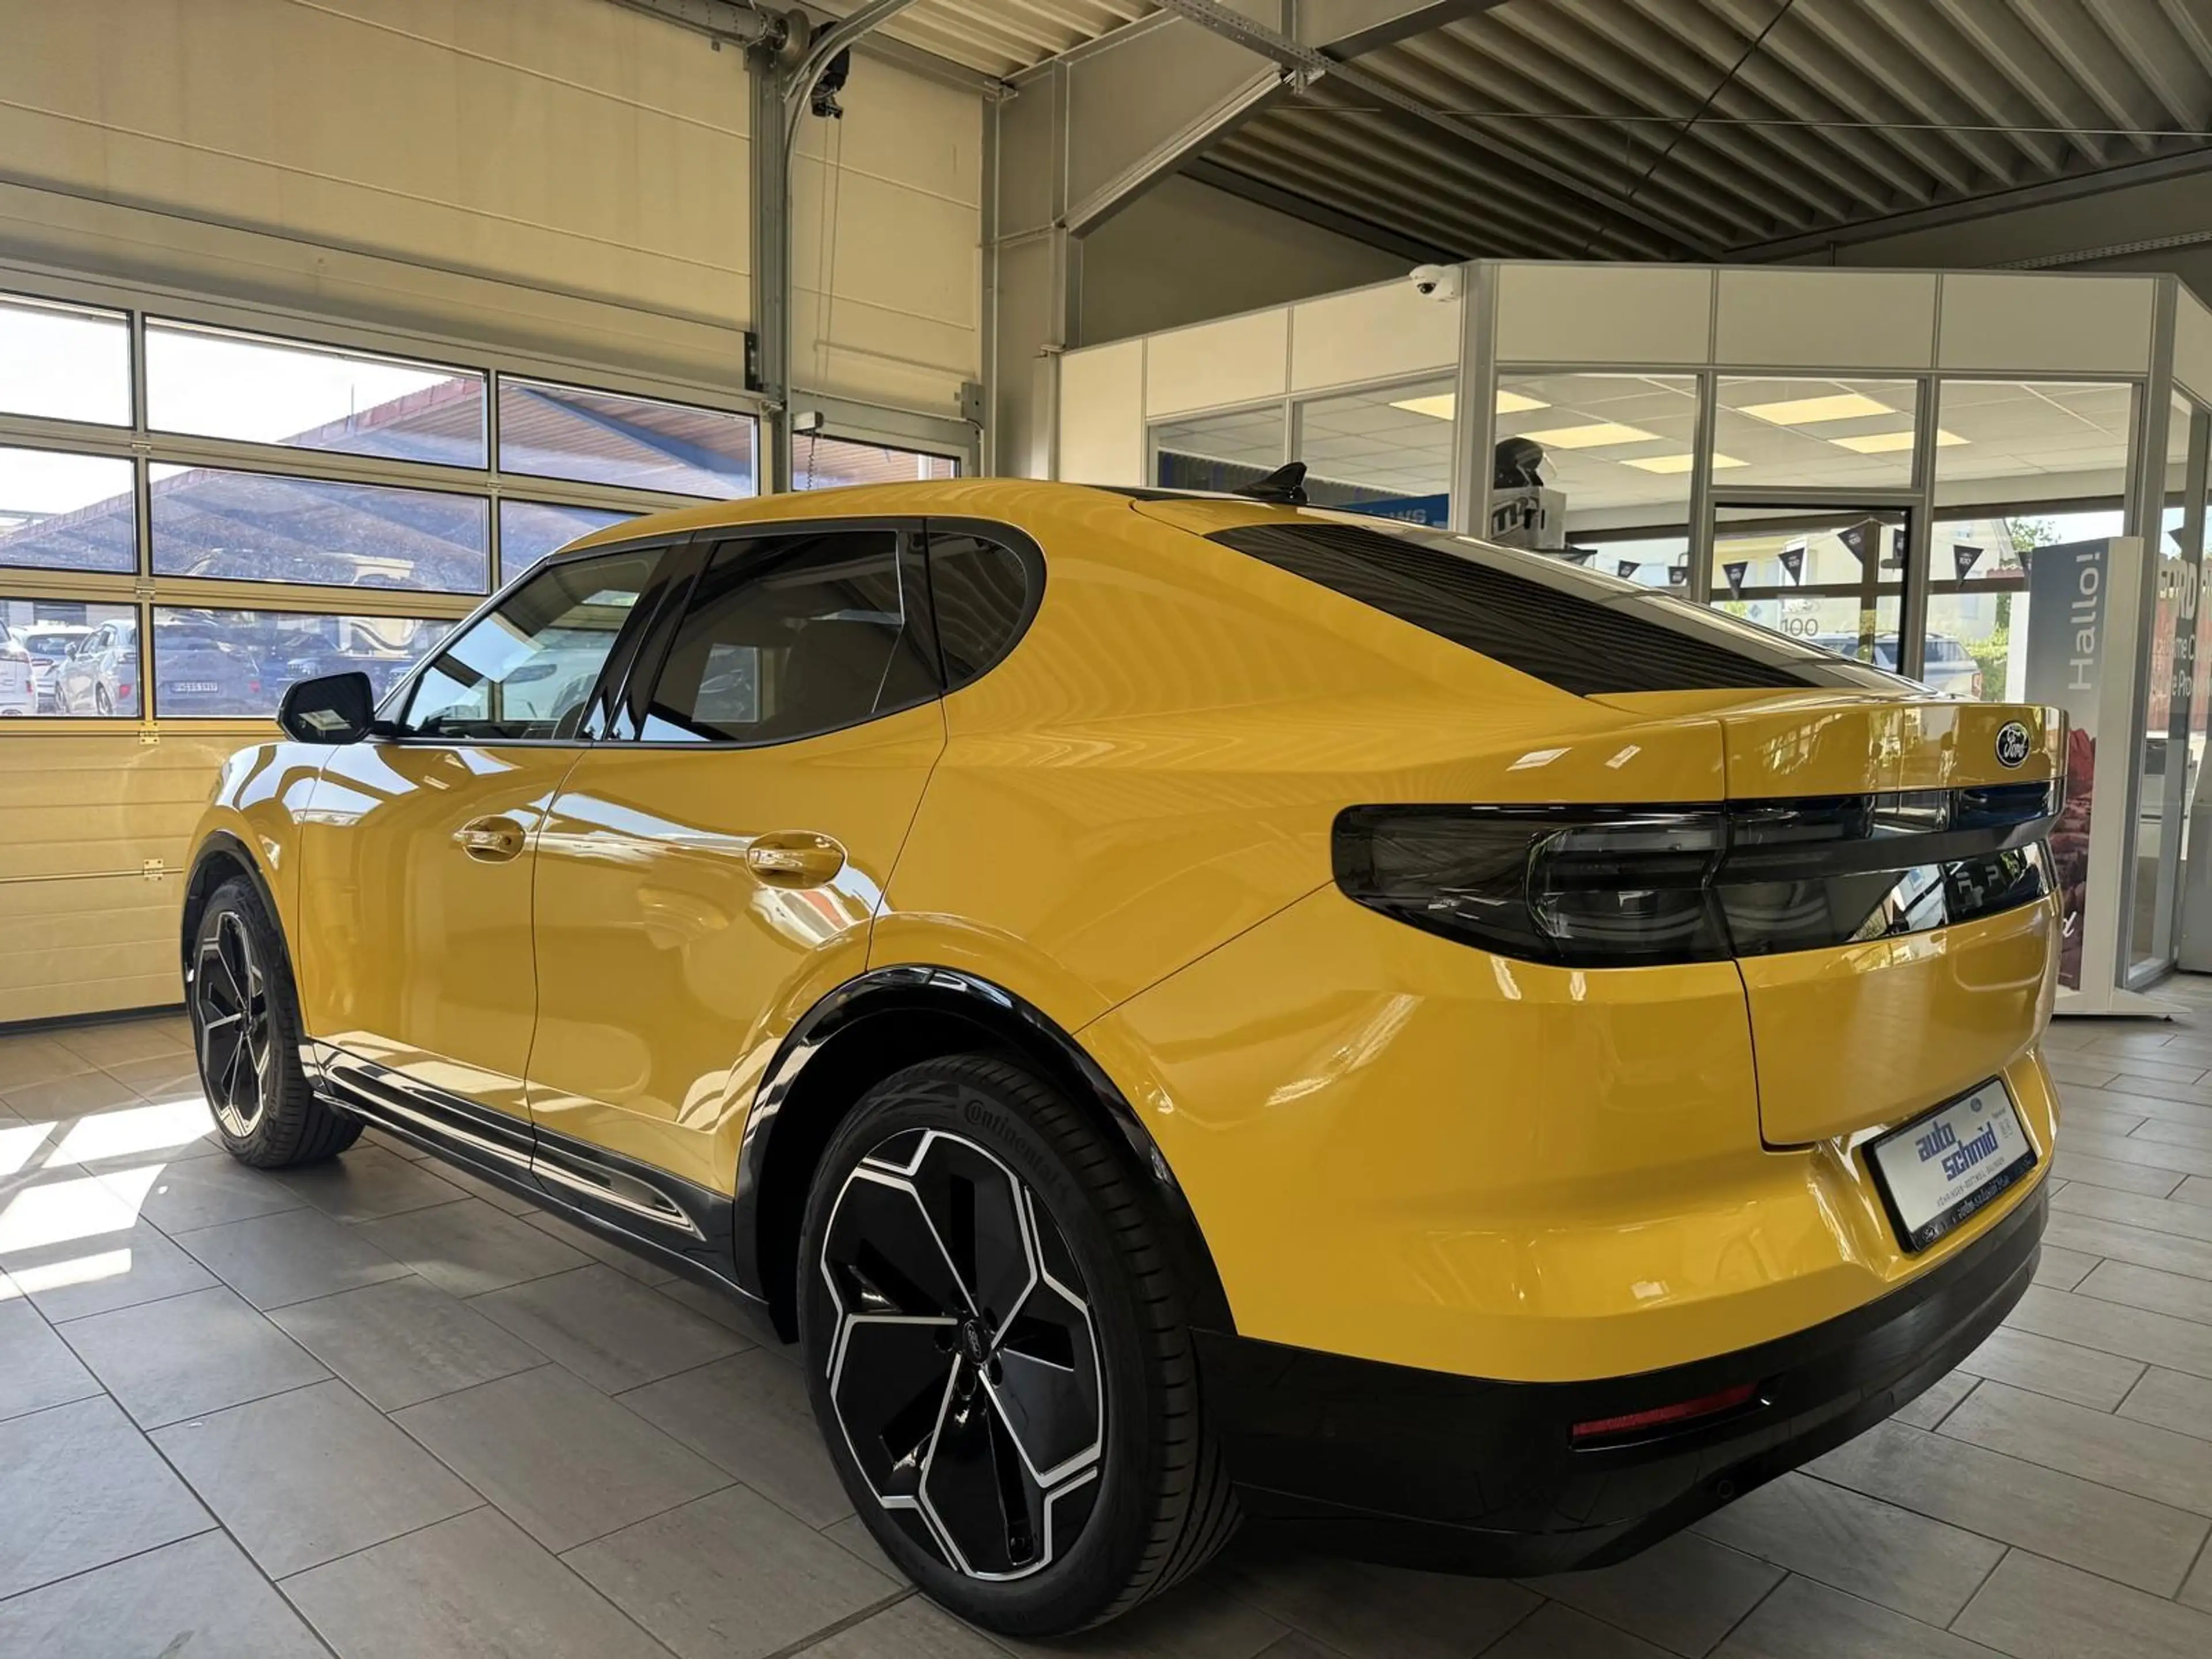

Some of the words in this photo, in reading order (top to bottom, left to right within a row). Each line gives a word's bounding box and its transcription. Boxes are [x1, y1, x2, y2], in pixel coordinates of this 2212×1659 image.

[1780, 618, 1819, 637] 100
[2068, 551, 2101, 690] Hallo!
[964, 1099, 1060, 1184] Continental
[1915, 1120, 1957, 1162] auto
[1940, 1120, 1999, 1181] schmid
